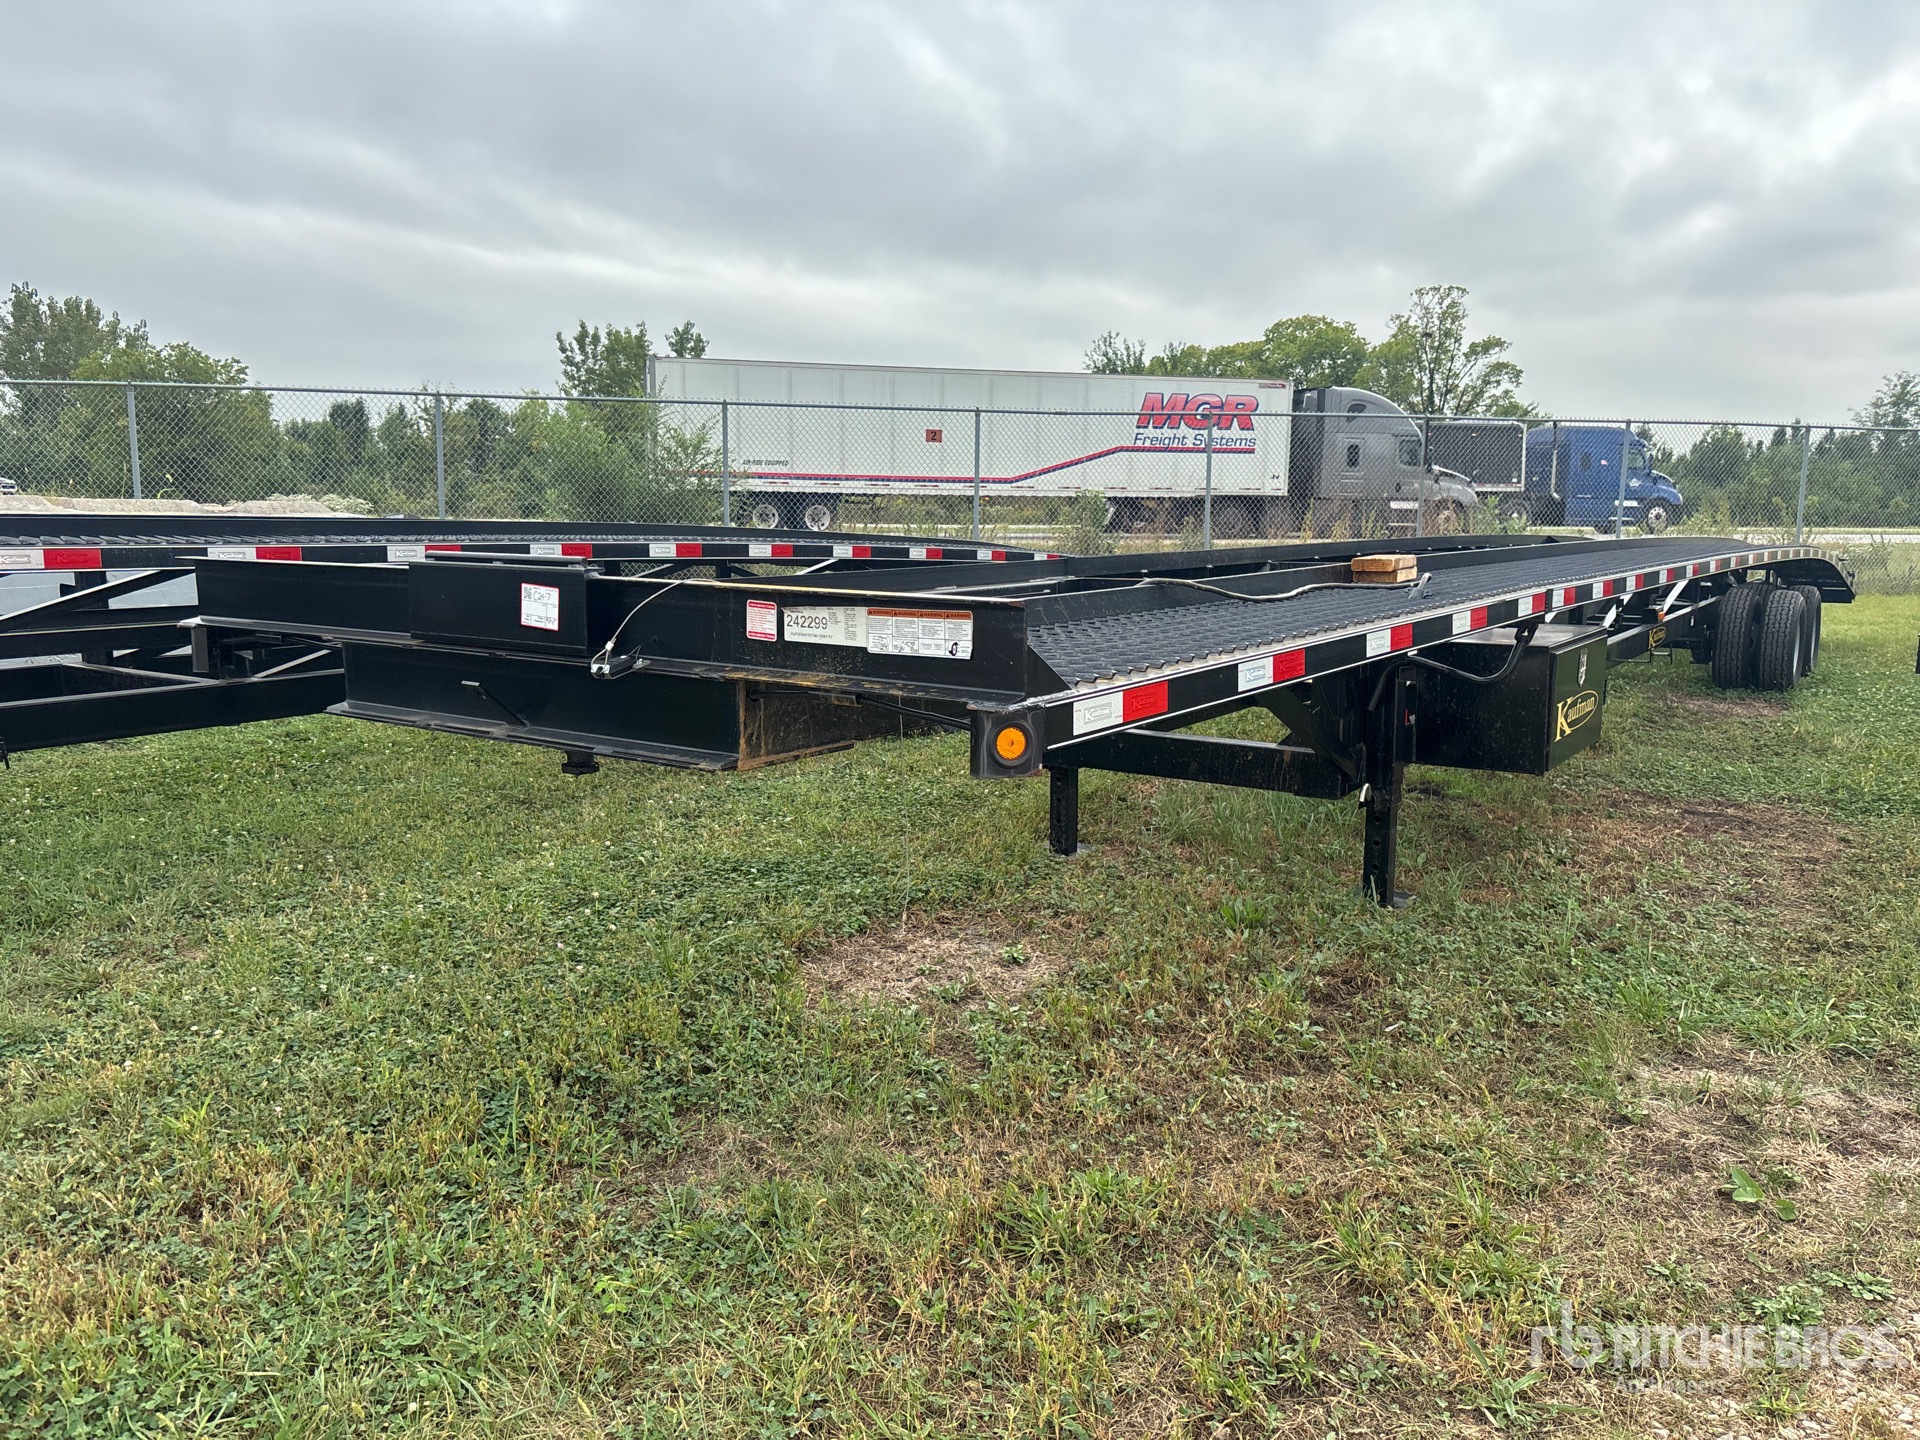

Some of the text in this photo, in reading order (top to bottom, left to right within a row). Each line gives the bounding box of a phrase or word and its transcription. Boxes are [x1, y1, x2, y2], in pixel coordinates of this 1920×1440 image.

[1135, 392, 1259, 431] MGR
[930, 431, 937, 441] 2
[1133, 432, 1187, 448] Freight
[786, 614, 828, 630] 242299
[1554, 694, 1596, 742] Kaufman
